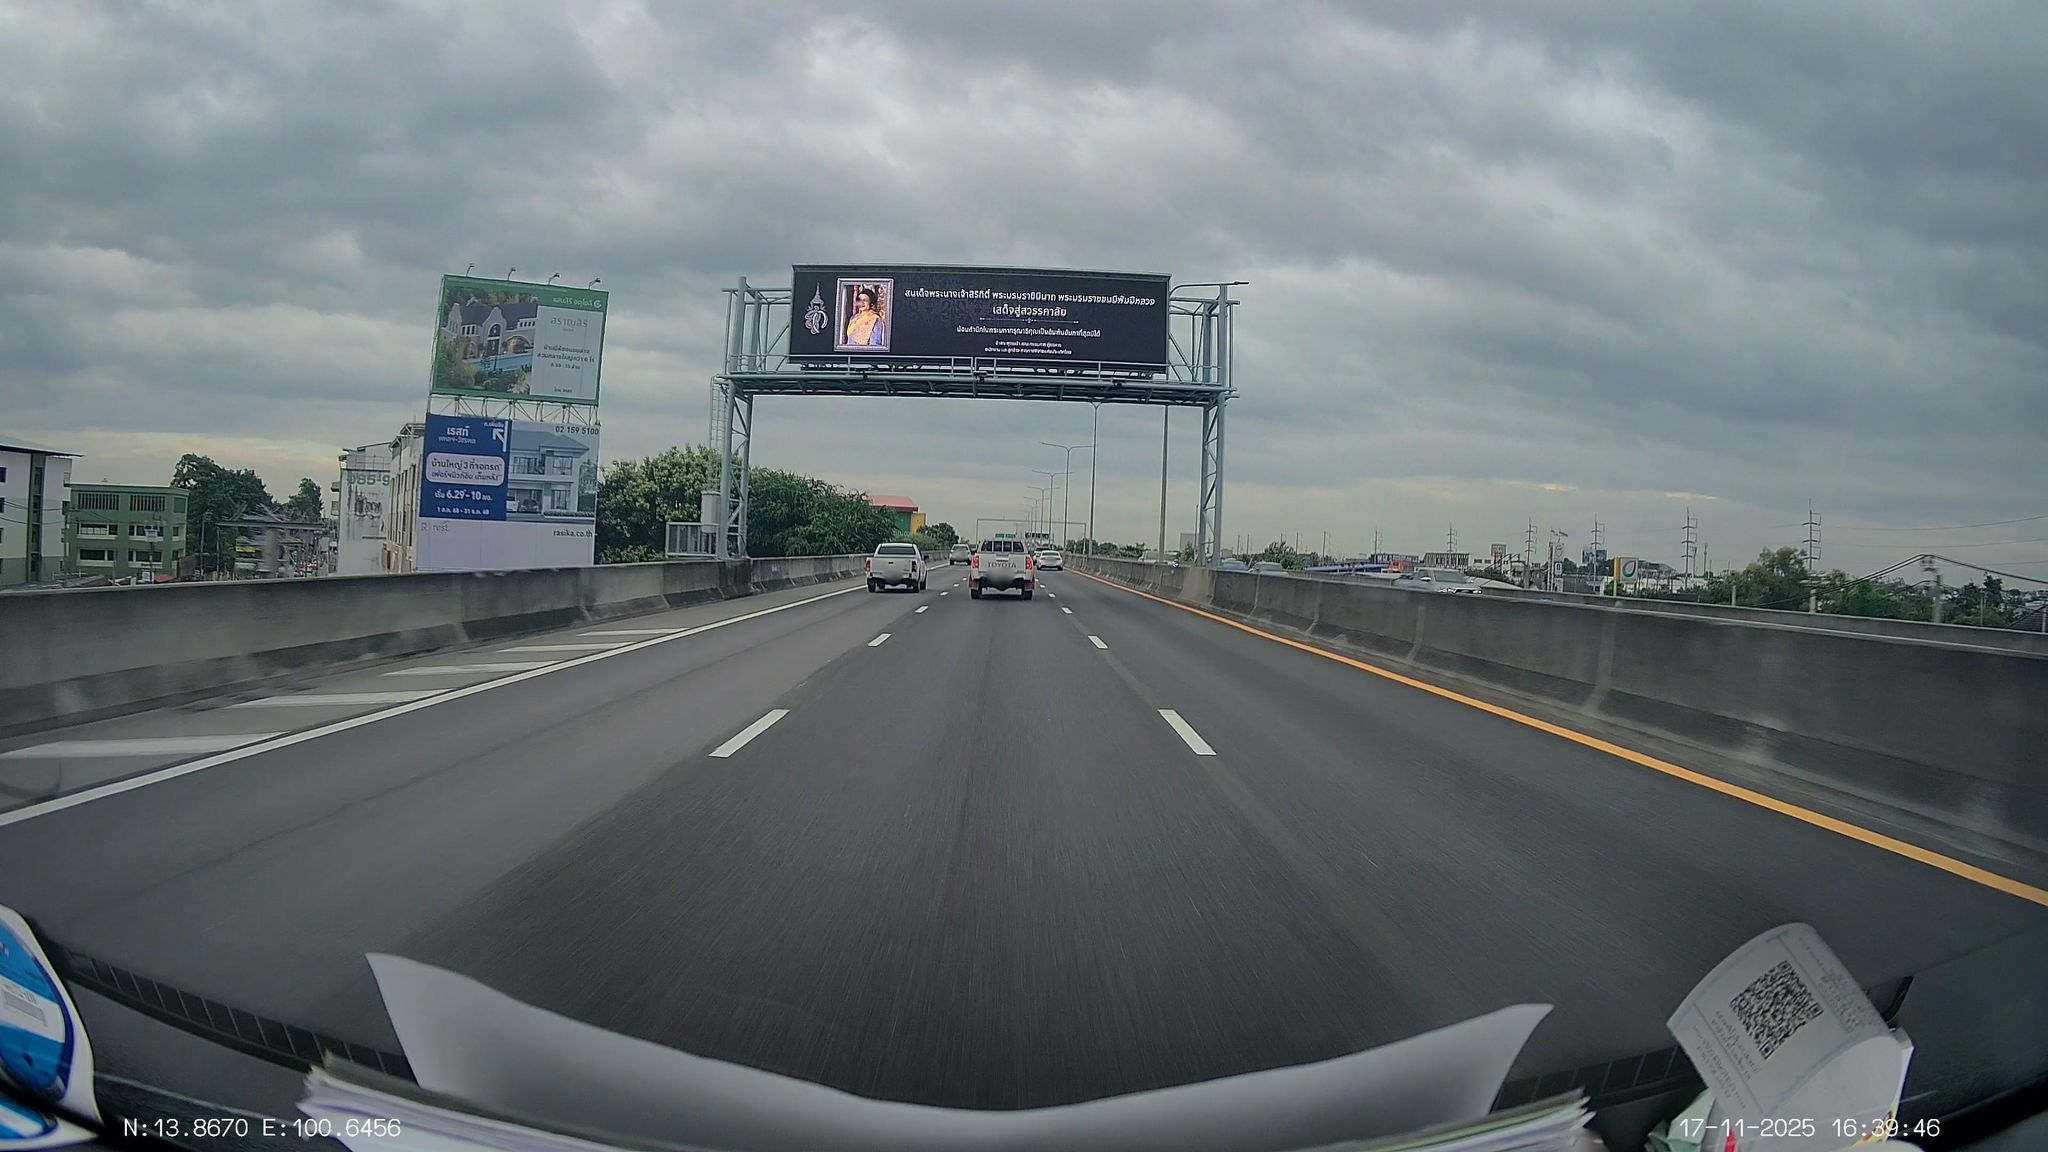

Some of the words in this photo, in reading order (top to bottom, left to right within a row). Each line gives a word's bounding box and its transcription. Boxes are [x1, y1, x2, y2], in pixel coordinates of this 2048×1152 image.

[992, 304, 1067, 319] เสด็จสู่สวรรคาลัย
[555, 425, 565, 433] 02
[567, 426, 580, 434] 159
[581, 427, 599, 435] 5100
[431, 457, 463, 470] บ้านใหญ่
[471, 490, 482, 501] 10
[553, 529, 593, 538] rasika.co.th
